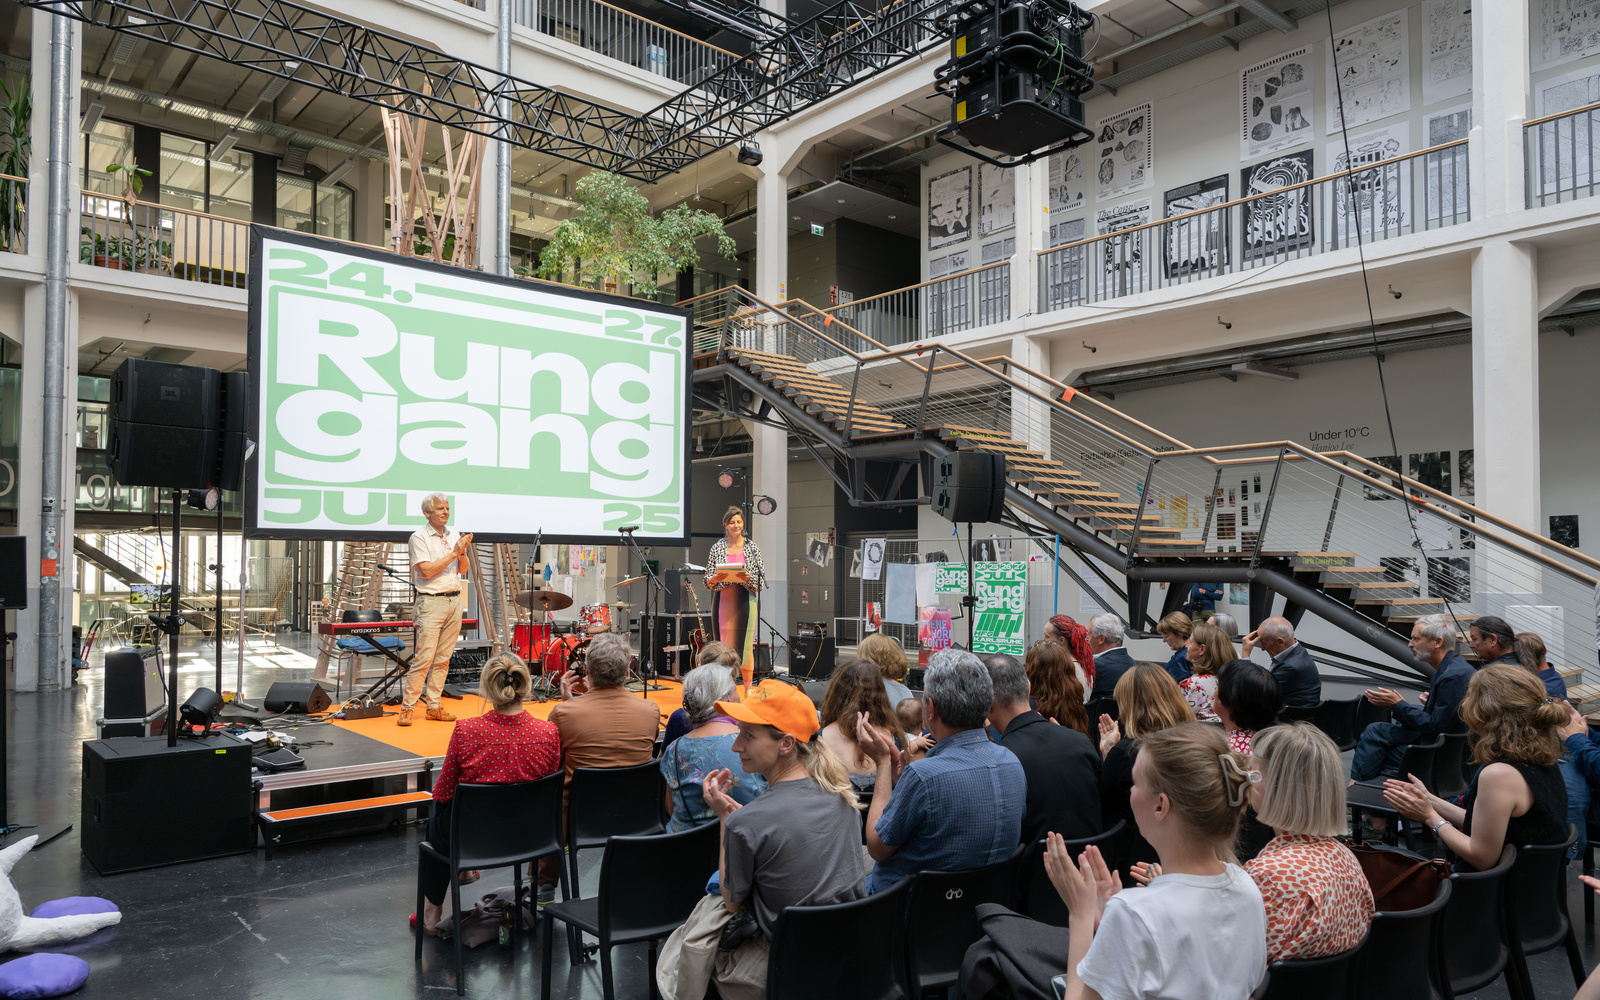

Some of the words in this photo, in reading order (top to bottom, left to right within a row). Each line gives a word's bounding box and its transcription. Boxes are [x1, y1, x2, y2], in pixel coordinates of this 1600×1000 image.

[269, 248, 413, 303] 24.
[605, 309, 682, 348] 27.
[276, 291, 675, 425] Rund
[1309, 430, 1342, 441] Under
[1344, 426, 1370, 438] 10°C
[274, 389, 675, 498] gang
[603, 502, 681, 533] 25
[984, 571, 1016, 580] JULI
[975, 581, 1025, 598] Rund
[975, 597, 1024, 613] gang
[923, 637, 949, 648] ZONTE
[973, 637, 1023, 645] KARLSRUHE
[973, 643, 1023, 654] 2025
